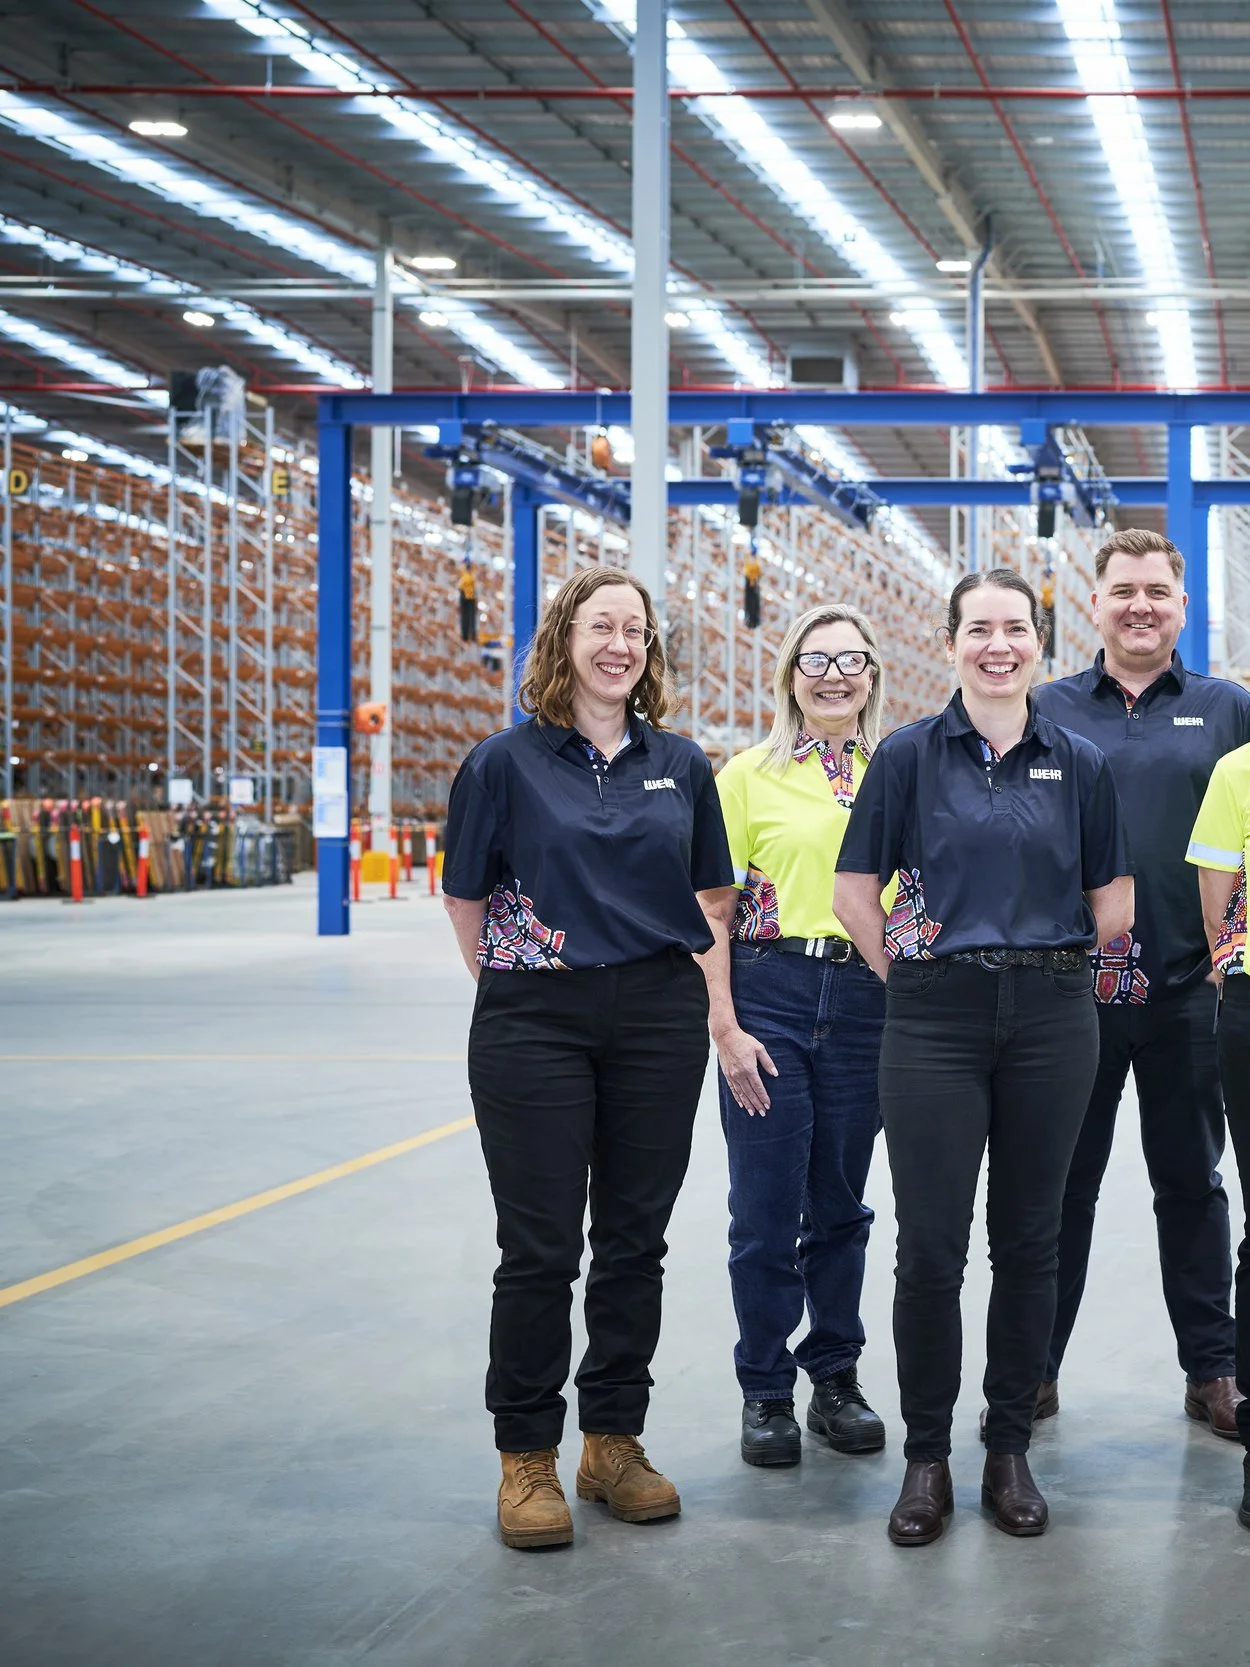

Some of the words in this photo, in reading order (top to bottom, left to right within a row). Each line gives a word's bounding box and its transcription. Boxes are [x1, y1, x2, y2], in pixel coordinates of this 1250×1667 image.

[9, 469, 28, 495] D
[272, 469, 288, 495] E
[1174, 716, 1204, 727] WEIR
[1029, 768, 1062, 781] WEIR
[643, 778, 676, 791] WEIR
